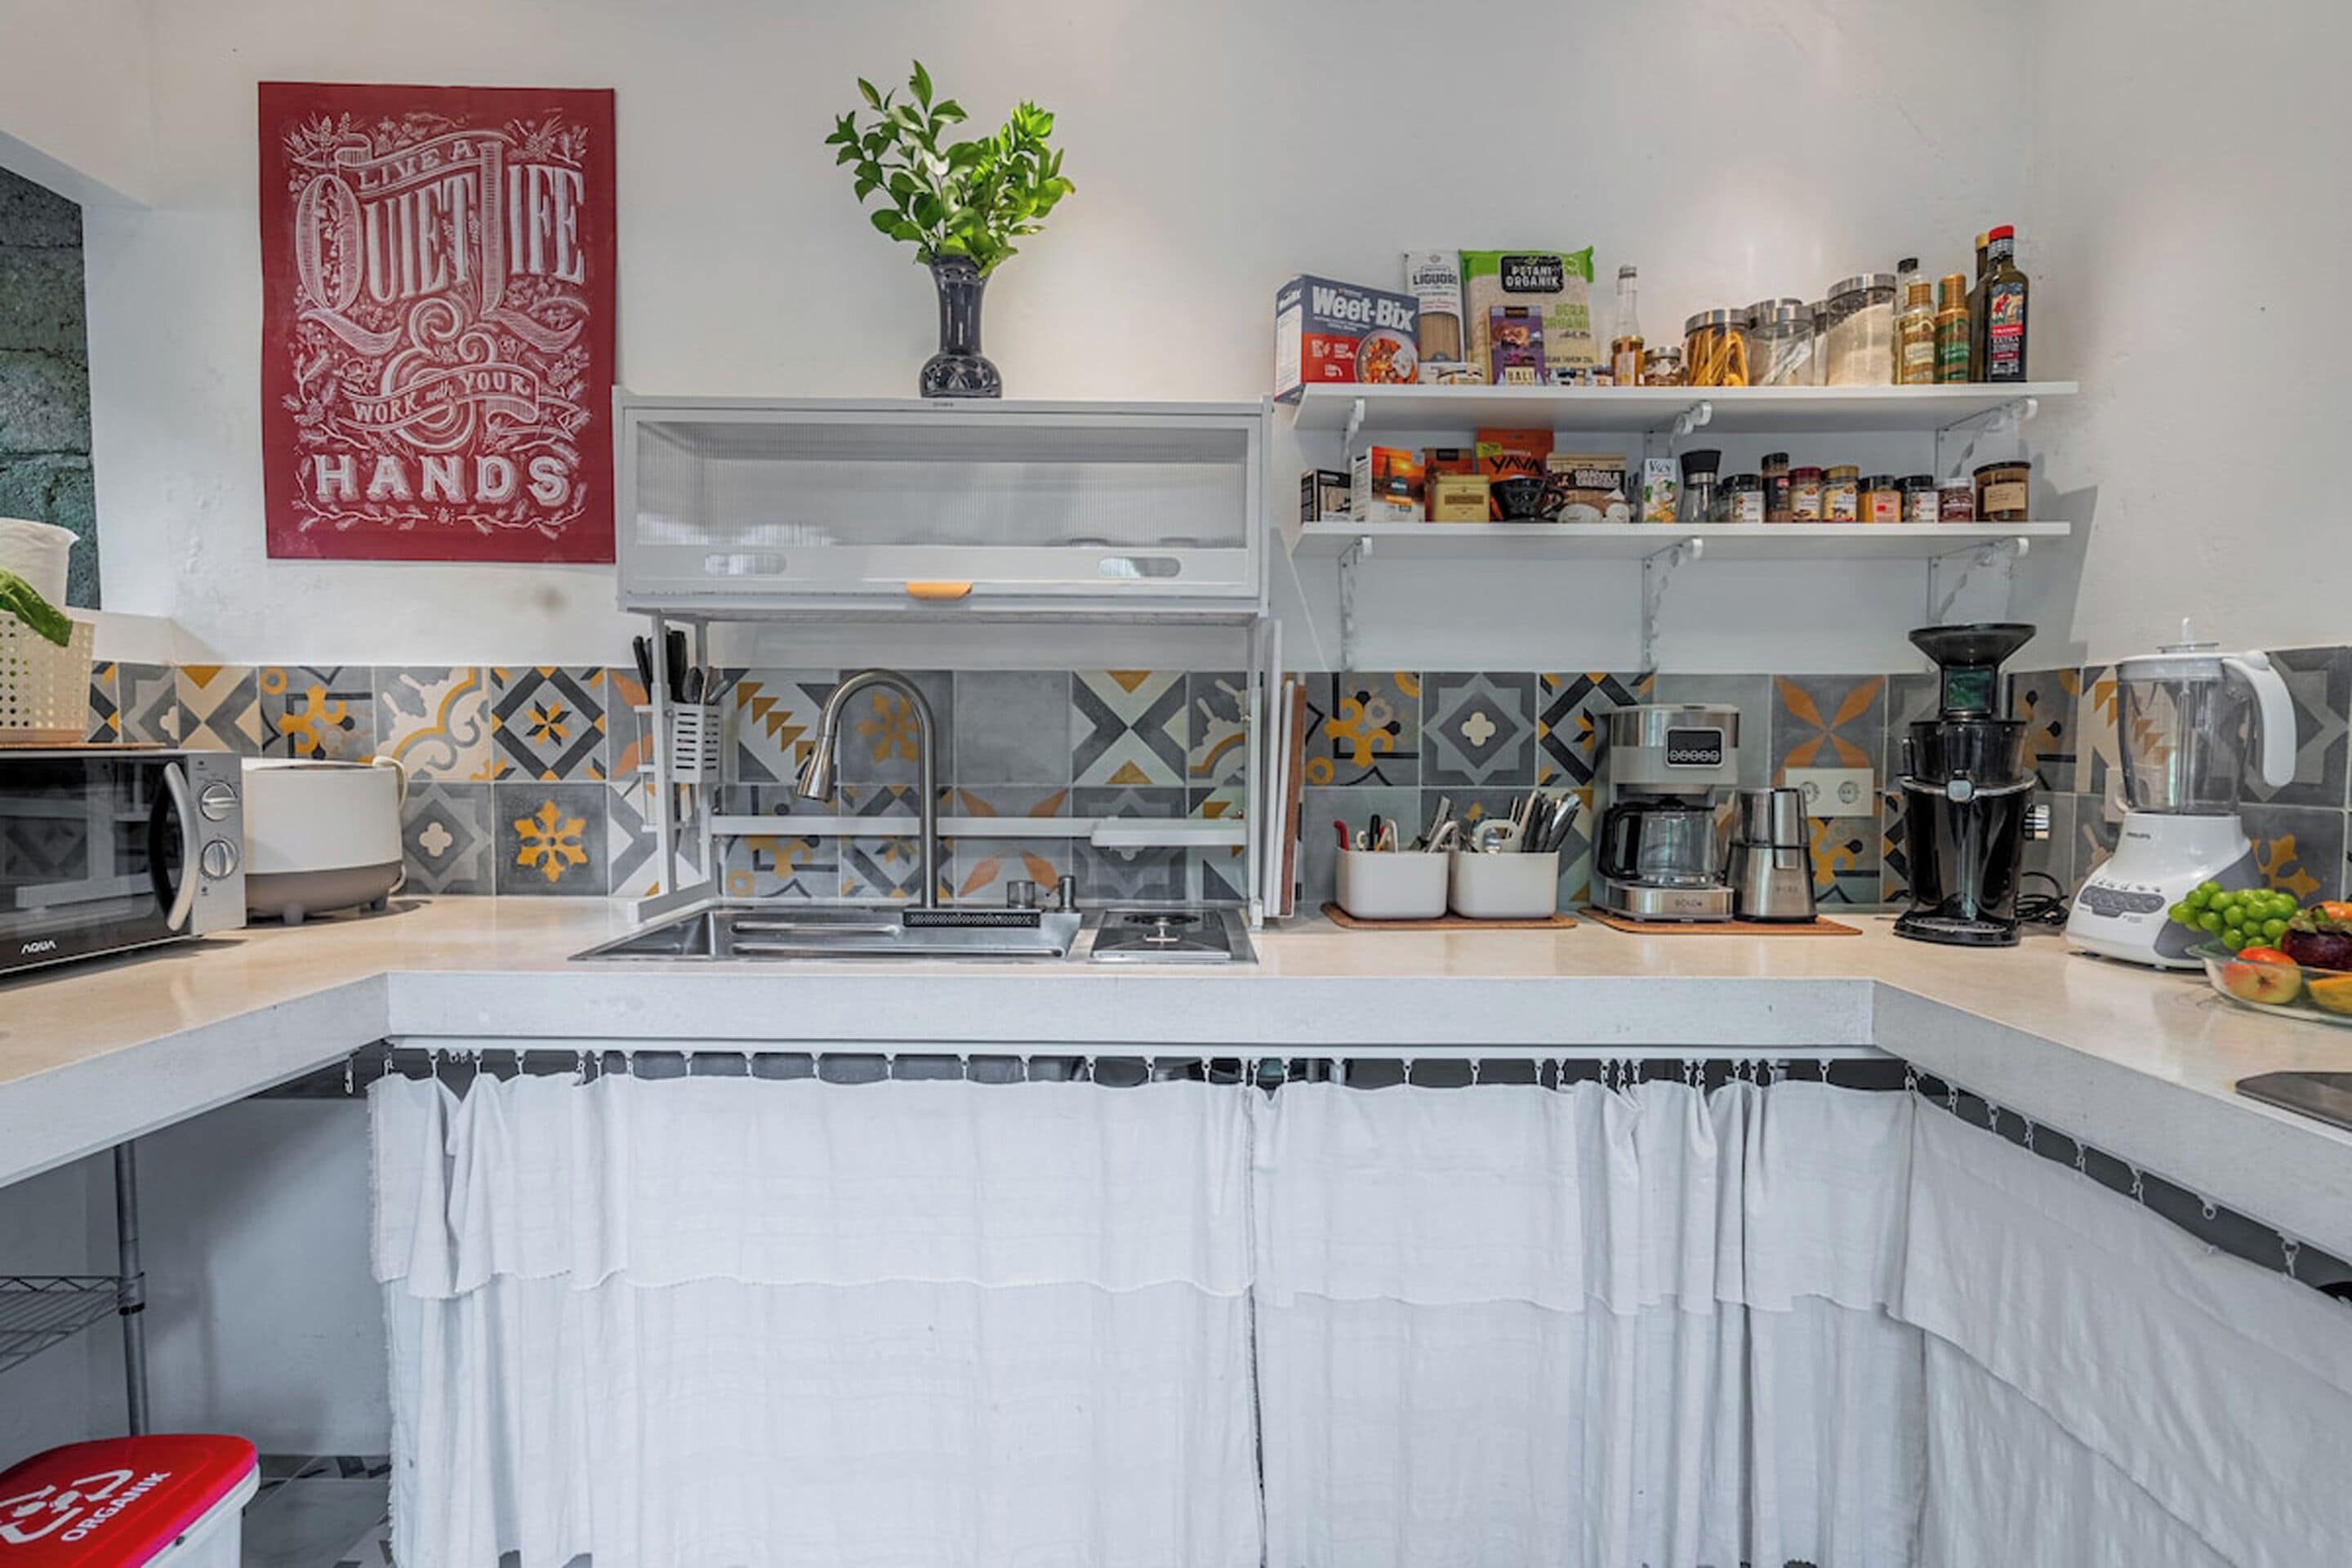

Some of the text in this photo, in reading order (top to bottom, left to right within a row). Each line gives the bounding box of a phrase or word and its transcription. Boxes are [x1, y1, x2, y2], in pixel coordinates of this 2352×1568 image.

[359, 140, 475, 189] LIVE A
[296, 140, 586, 347] QUIET LIFE
[1505, 276, 1560, 288] ORGANIK
[1512, 266, 1552, 275] PETANI
[1312, 286, 1415, 332] Weet-Bix
[352, 371, 532, 423] WORK with YOUR
[313, 454, 570, 506] HANDS
[21, 940, 56, 955] AQUA
[60, 1471, 171, 1542] ORGANIK
